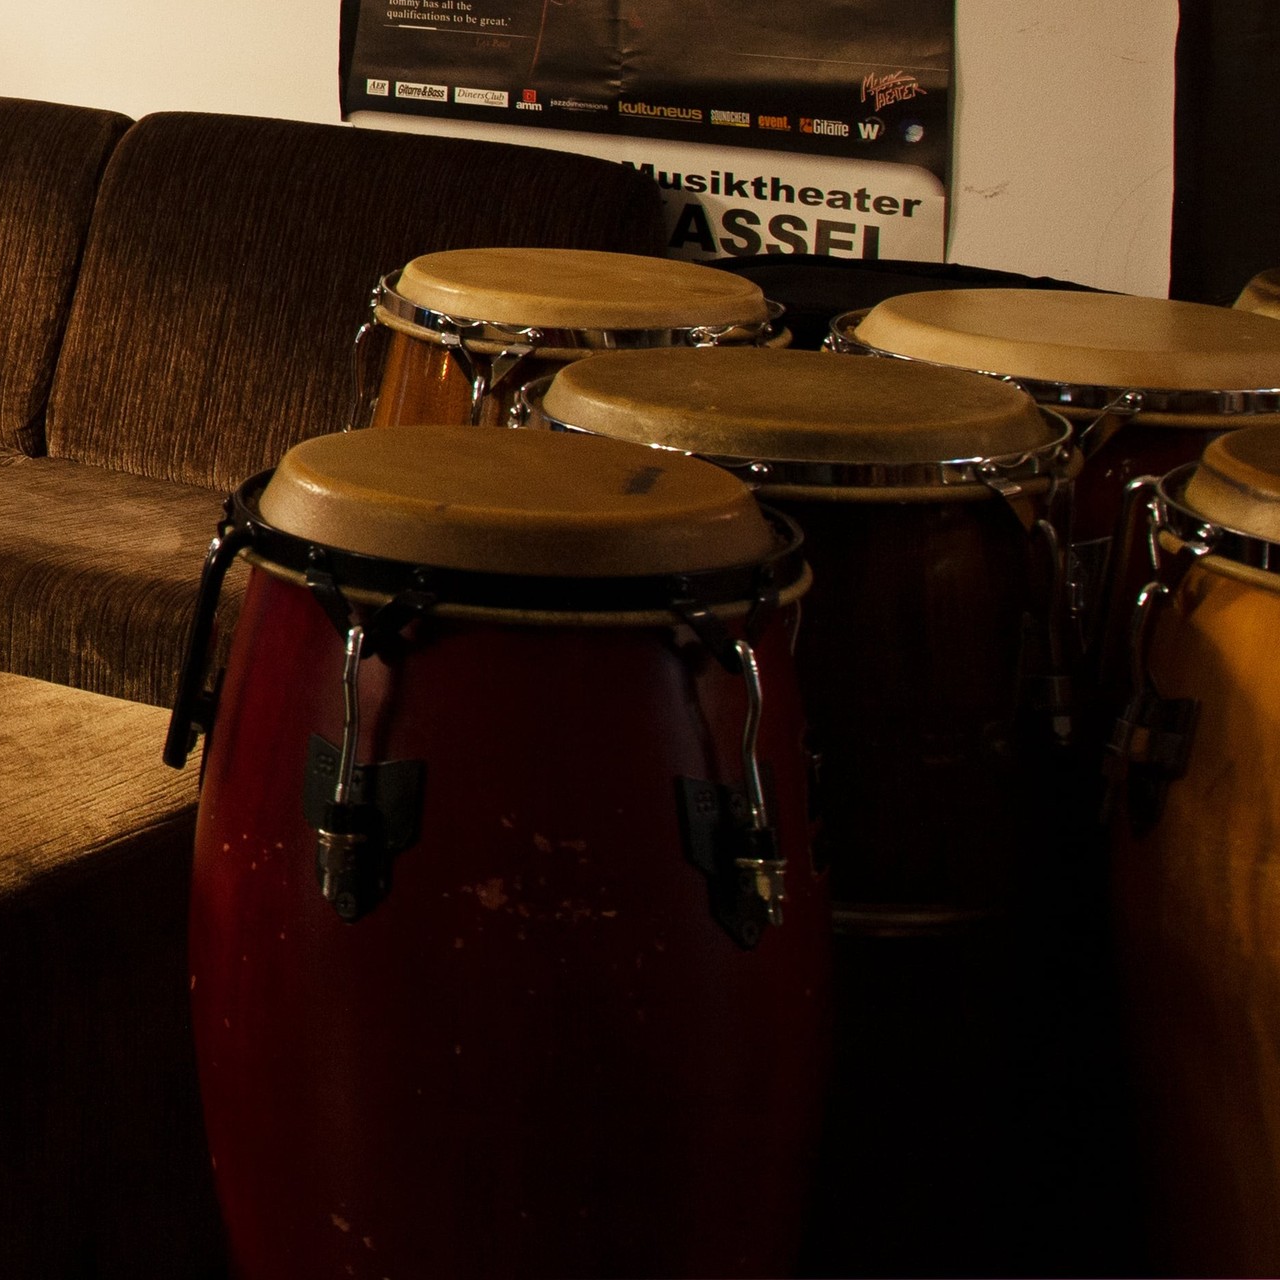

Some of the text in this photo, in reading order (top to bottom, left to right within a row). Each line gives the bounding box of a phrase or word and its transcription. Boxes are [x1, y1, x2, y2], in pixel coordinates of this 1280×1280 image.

[441, 0, 454, 10] all
[456, 1, 472, 11] the
[386, 9, 477, 24] qualifications be
